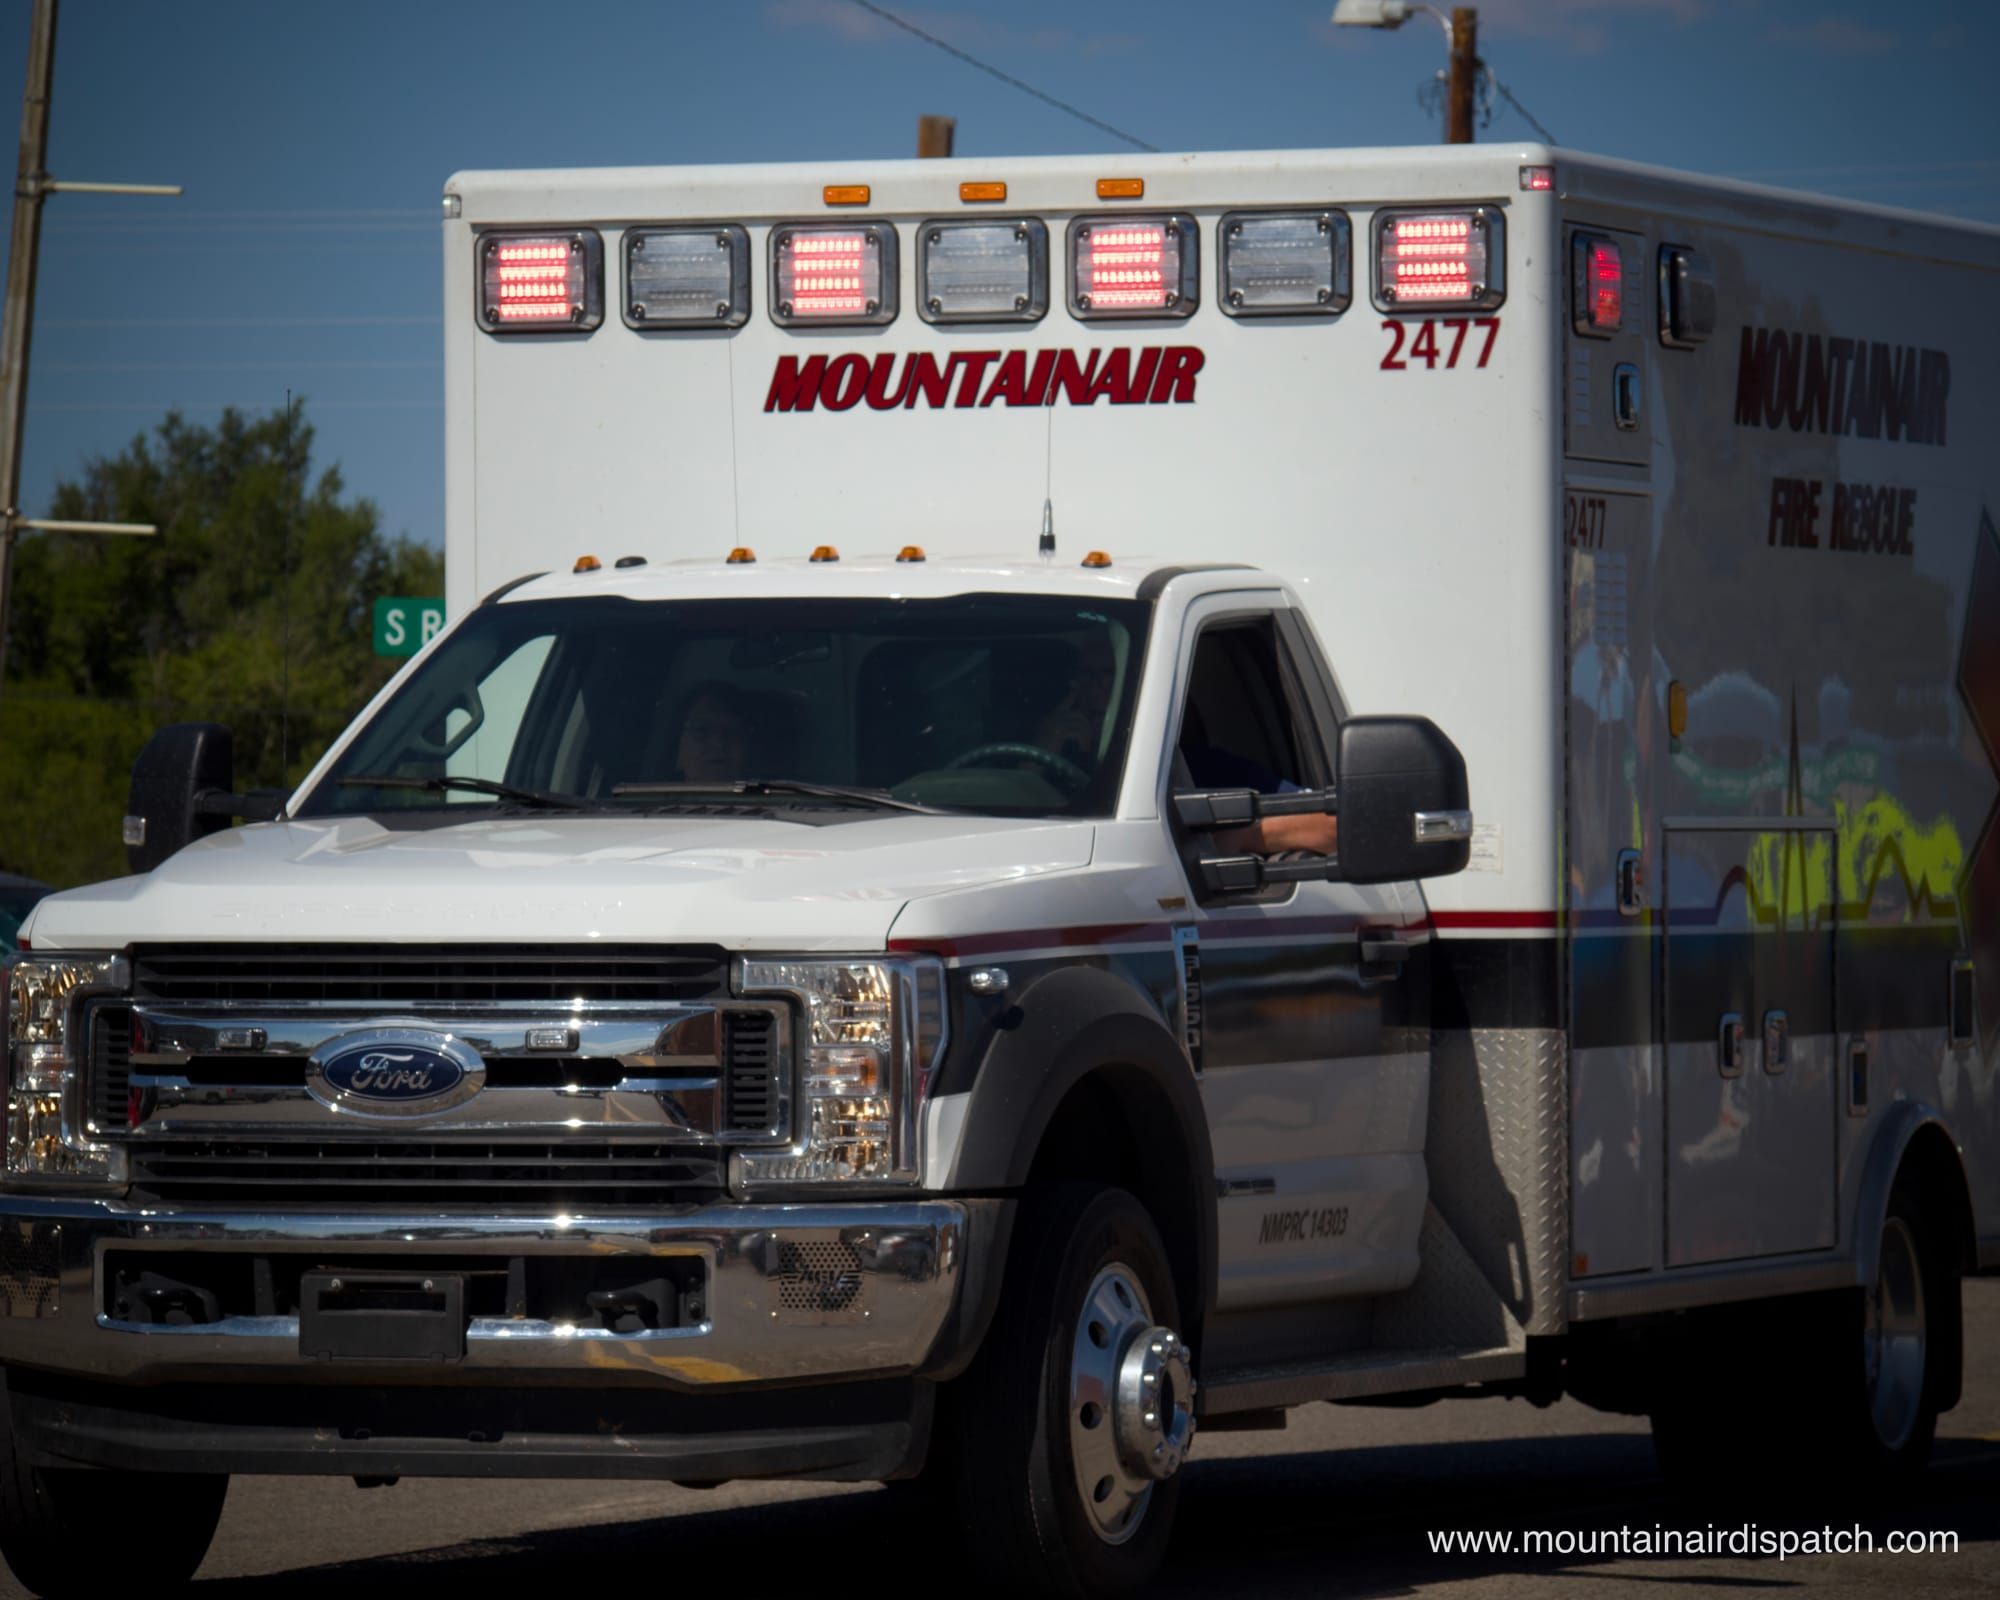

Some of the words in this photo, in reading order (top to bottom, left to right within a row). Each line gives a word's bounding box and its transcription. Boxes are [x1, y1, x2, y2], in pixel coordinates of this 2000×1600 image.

[1380, 317, 1502, 370] 2477
[763, 346, 1206, 413] MOUNTAINAIR
[1733, 325, 1951, 447] MOUNTAINAIR
[1569, 496, 1607, 549] 2477
[1768, 477, 1822, 549] FIRE
[1829, 481, 1917, 555] RESCUE
[385, 608, 405, 646] S
[351, 1052, 435, 1090] Ford
[1258, 1208, 1310, 1246] NMPRC
[1310, 1206, 1349, 1240] 14303
